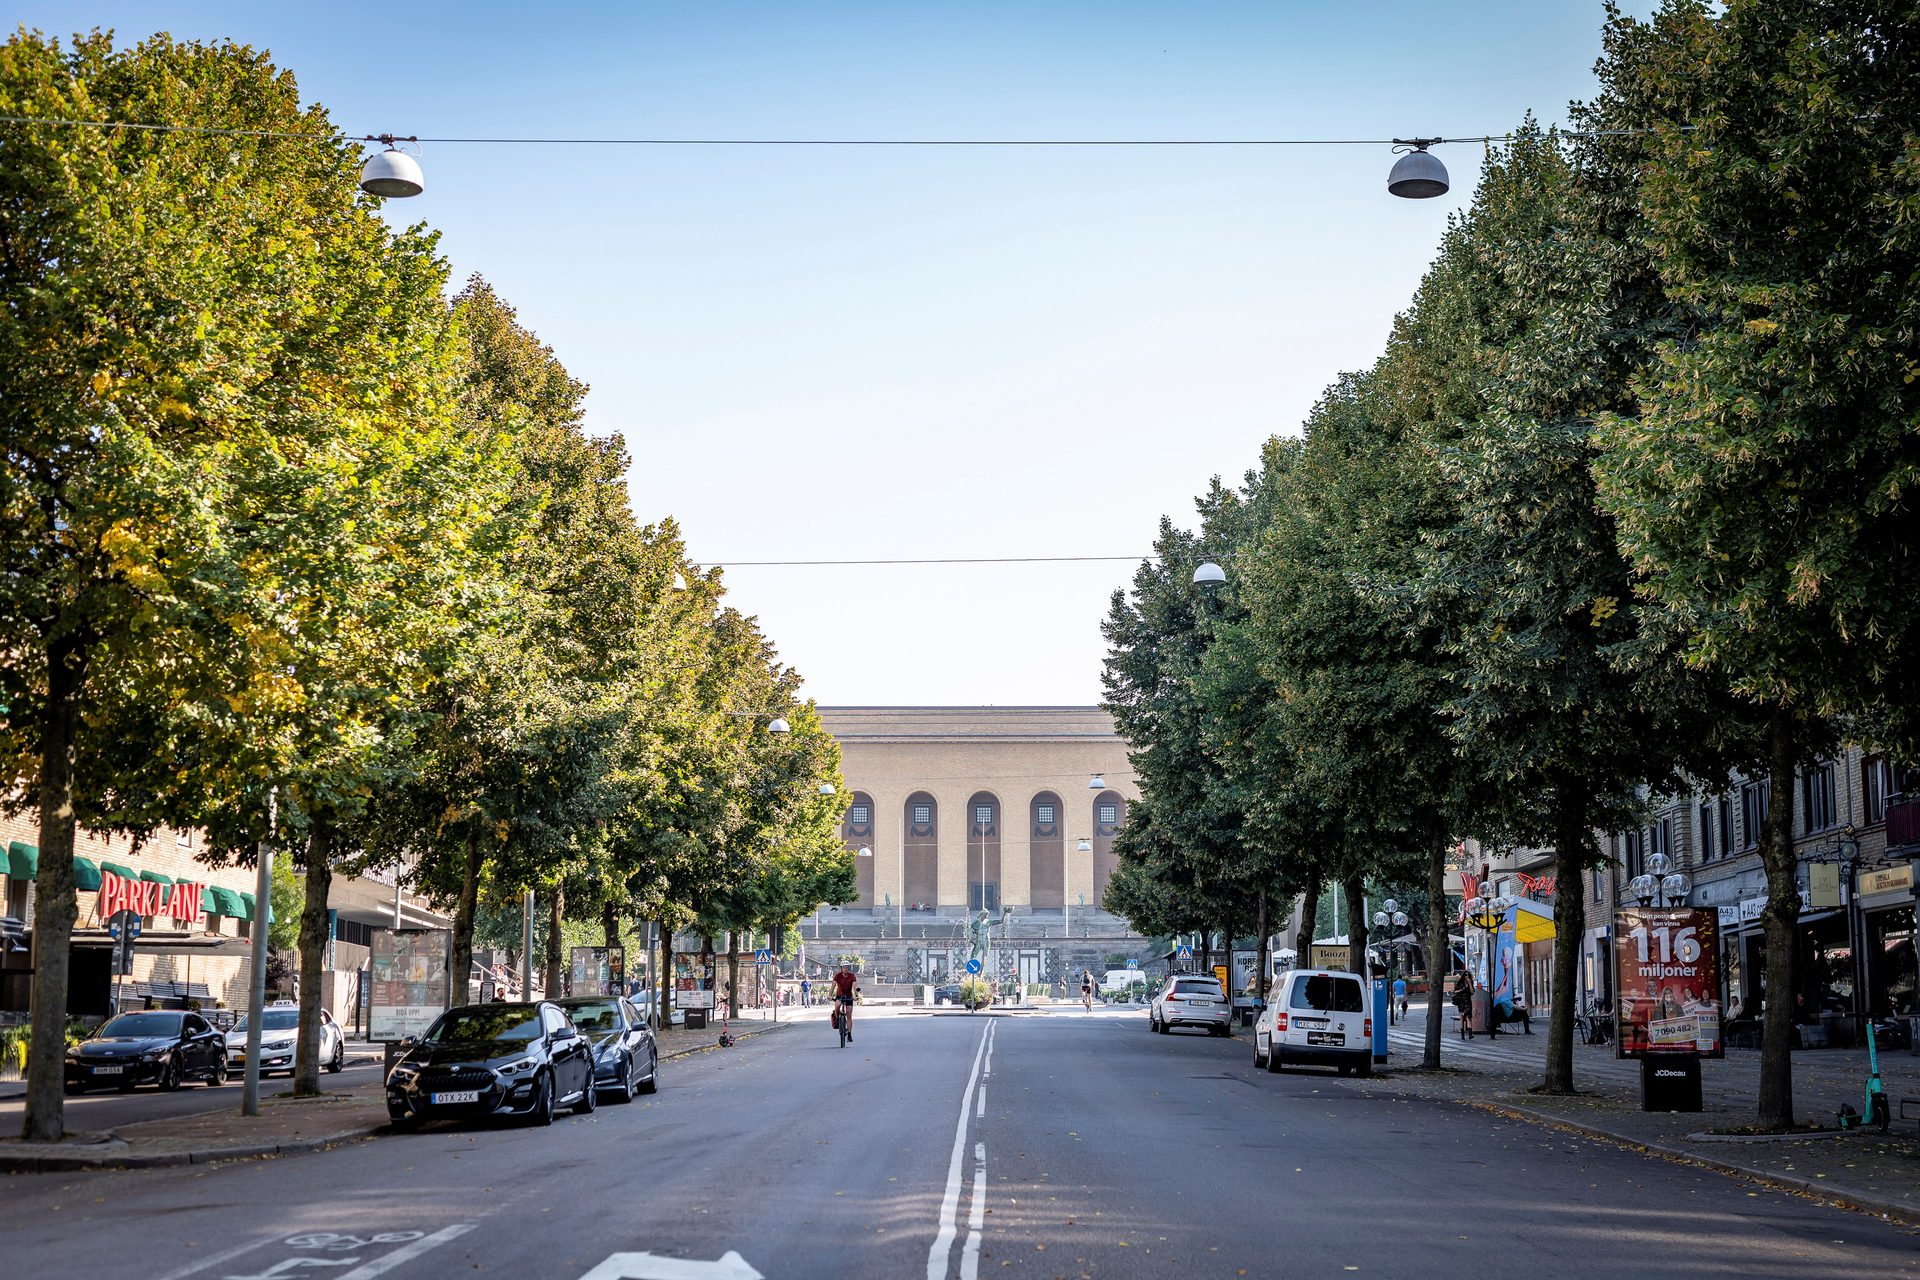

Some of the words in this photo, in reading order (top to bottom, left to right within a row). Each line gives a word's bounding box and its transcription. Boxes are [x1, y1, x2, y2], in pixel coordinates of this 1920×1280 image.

[100, 870, 154, 918] PARK
[154, 881, 206, 924] LANE
[1629, 926, 1701, 963] 116
[1237, 957, 1257, 966] KORE
[1638, 963, 1697, 980] miljoner
[1661, 1027, 1676, 1035] 090
[1677, 1024, 1691, 1032] 482
[438, 1094, 455, 1102] OTX
[457, 1092, 474, 1101] 22K
